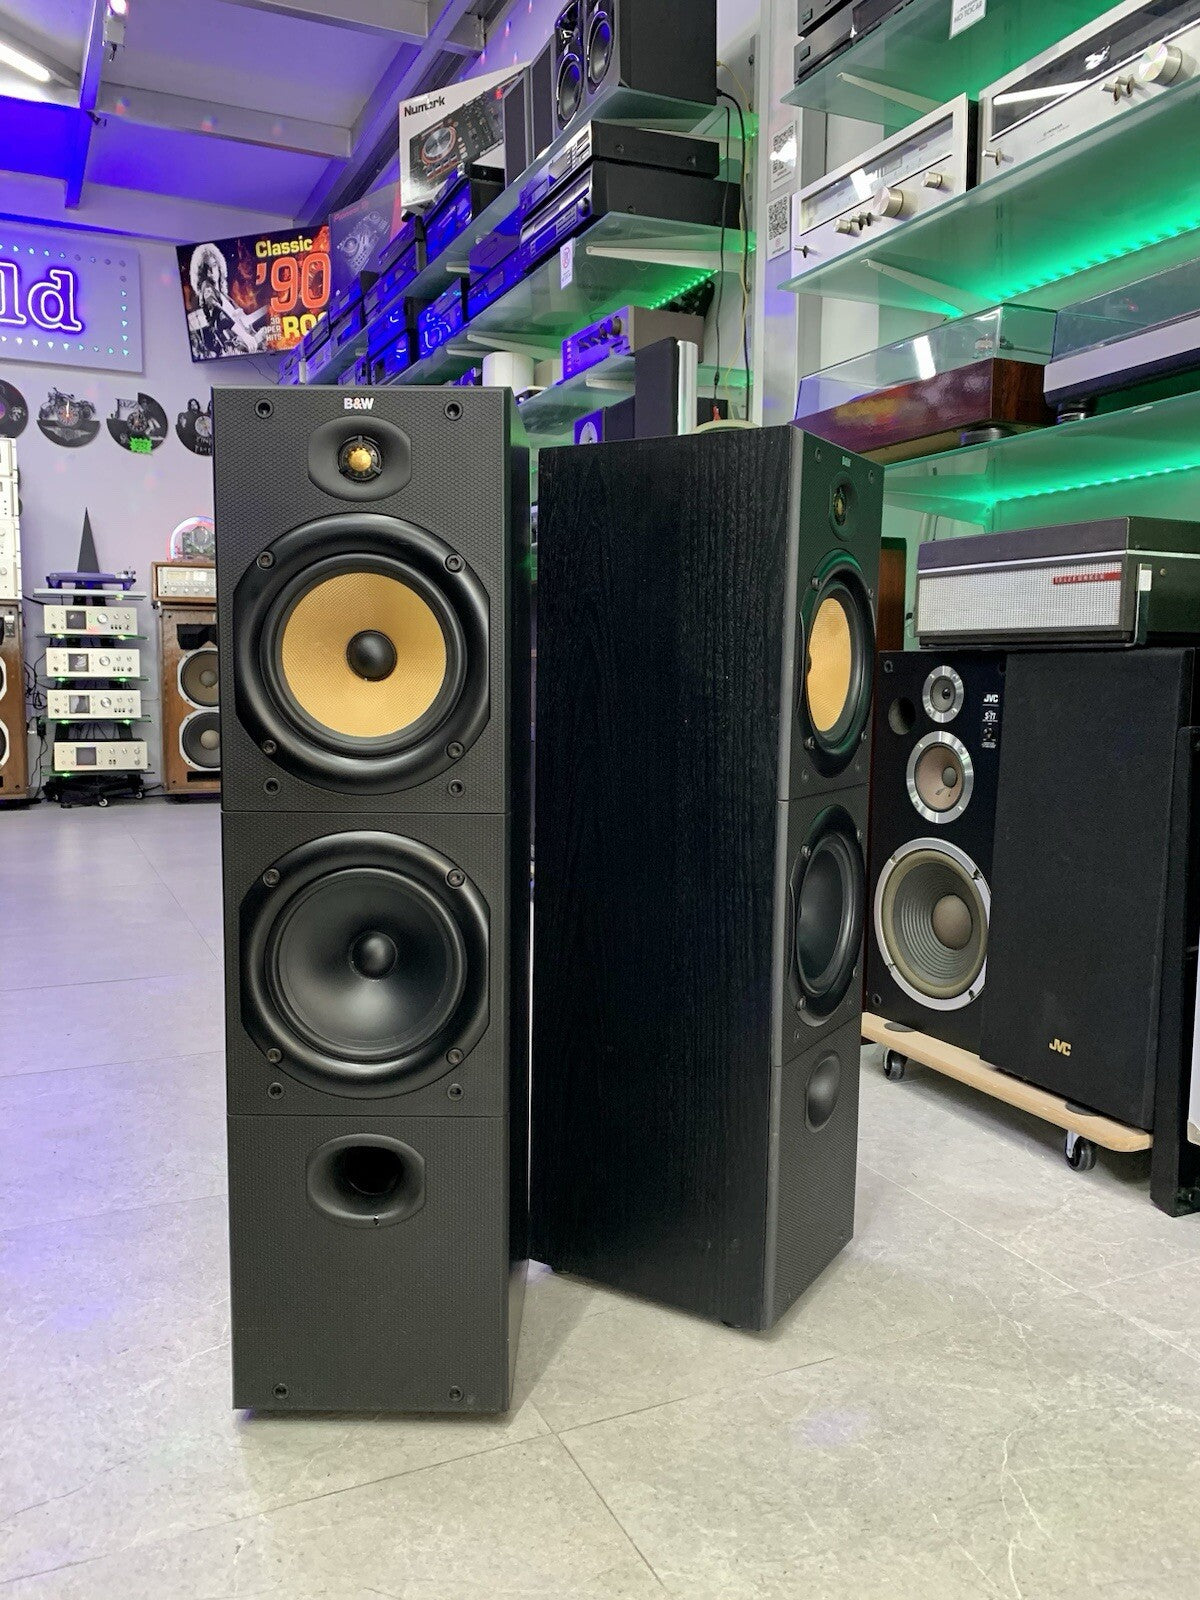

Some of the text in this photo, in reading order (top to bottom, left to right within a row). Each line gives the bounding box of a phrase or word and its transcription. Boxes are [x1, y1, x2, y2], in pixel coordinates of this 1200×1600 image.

[255, 235, 313, 258] Classic
[343, 397, 375, 410] B&W
[983, 693, 999, 703] JVC
[1049, 1038, 1071, 1057] JVC
